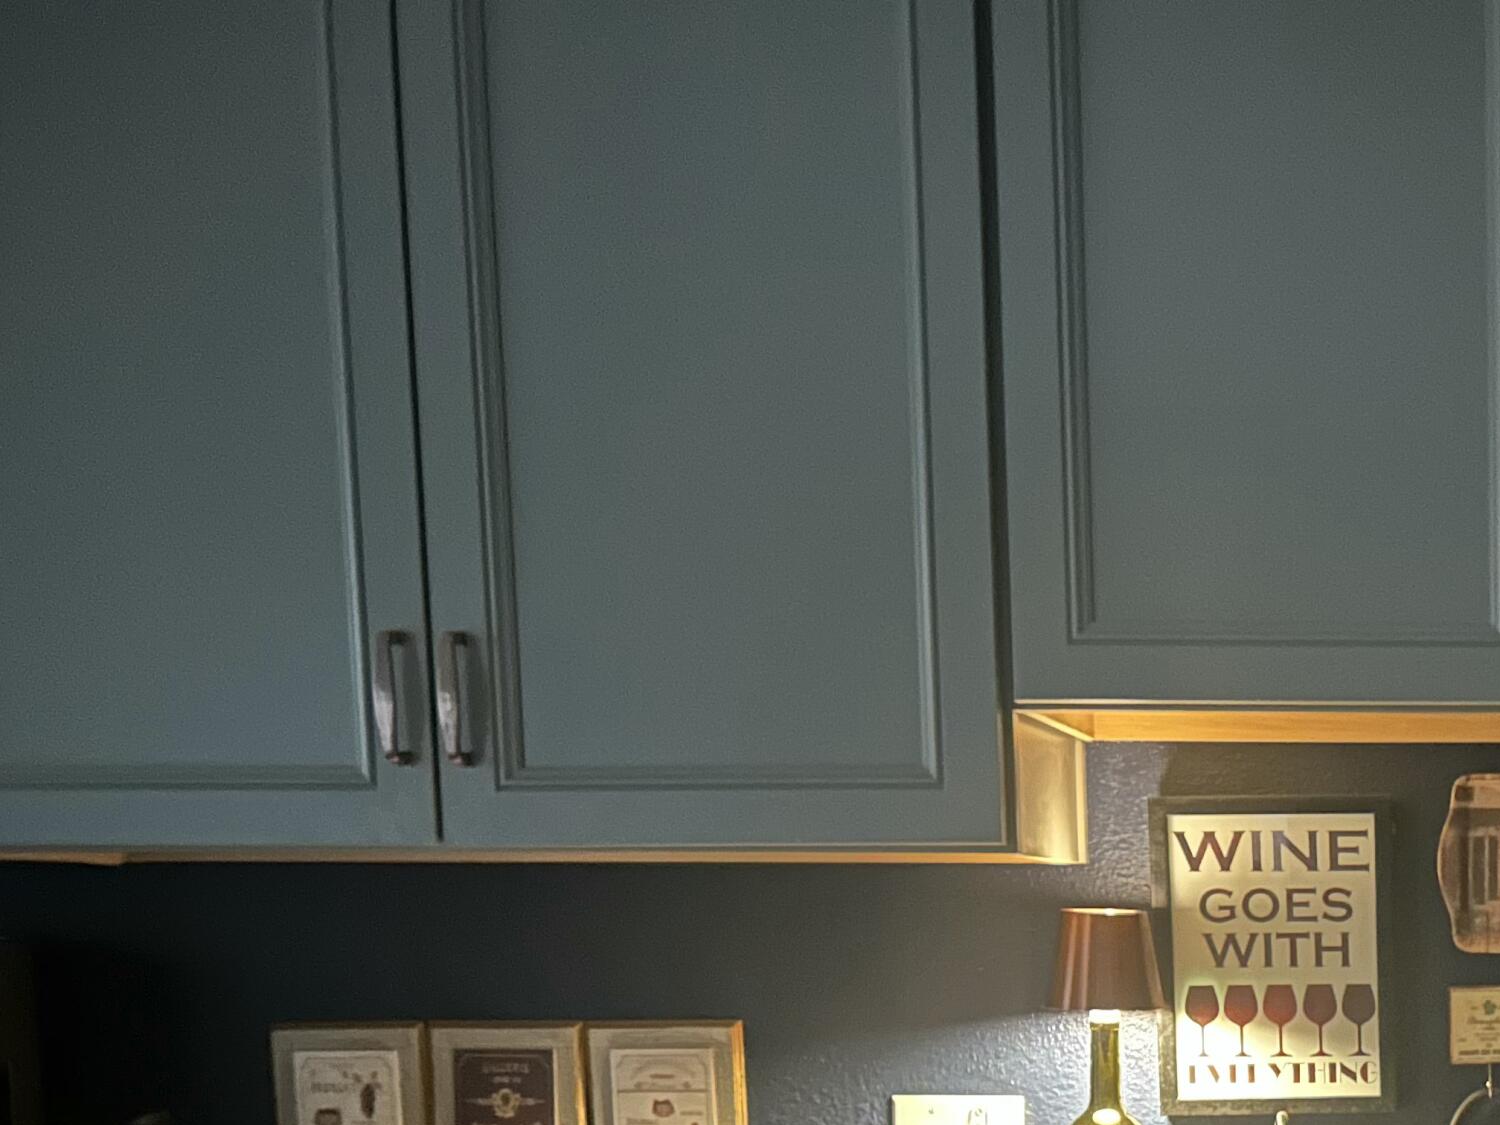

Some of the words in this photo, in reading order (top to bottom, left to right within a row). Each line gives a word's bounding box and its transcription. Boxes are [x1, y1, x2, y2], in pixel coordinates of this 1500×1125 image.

[1172, 830, 1371, 872] WINE
[1199, 887, 1354, 924] GOES
[1202, 931, 1352, 969] WITH
